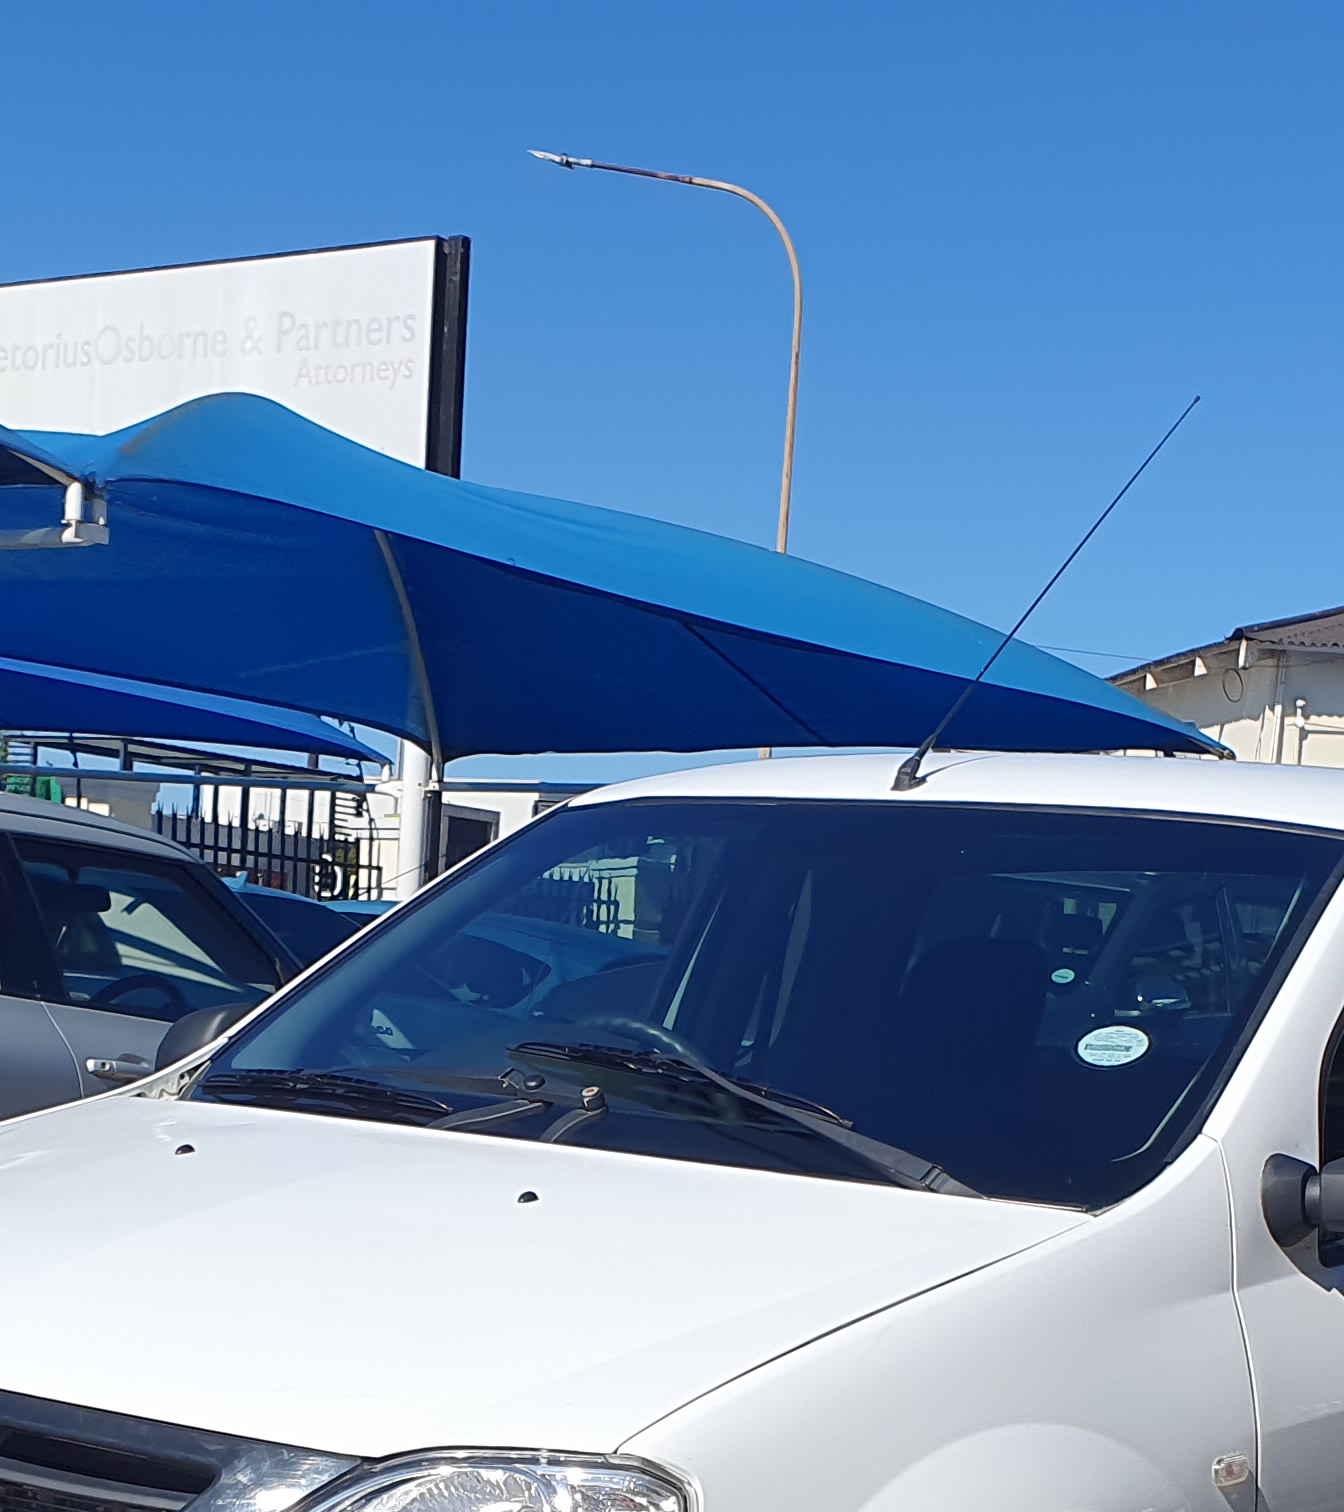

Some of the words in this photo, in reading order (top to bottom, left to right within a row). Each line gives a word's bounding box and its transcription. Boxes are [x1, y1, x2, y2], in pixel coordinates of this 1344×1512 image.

[240, 315, 263, 356] &
[276, 311, 416, 354] Partners
[293, 358, 414, 391] Attorneys
